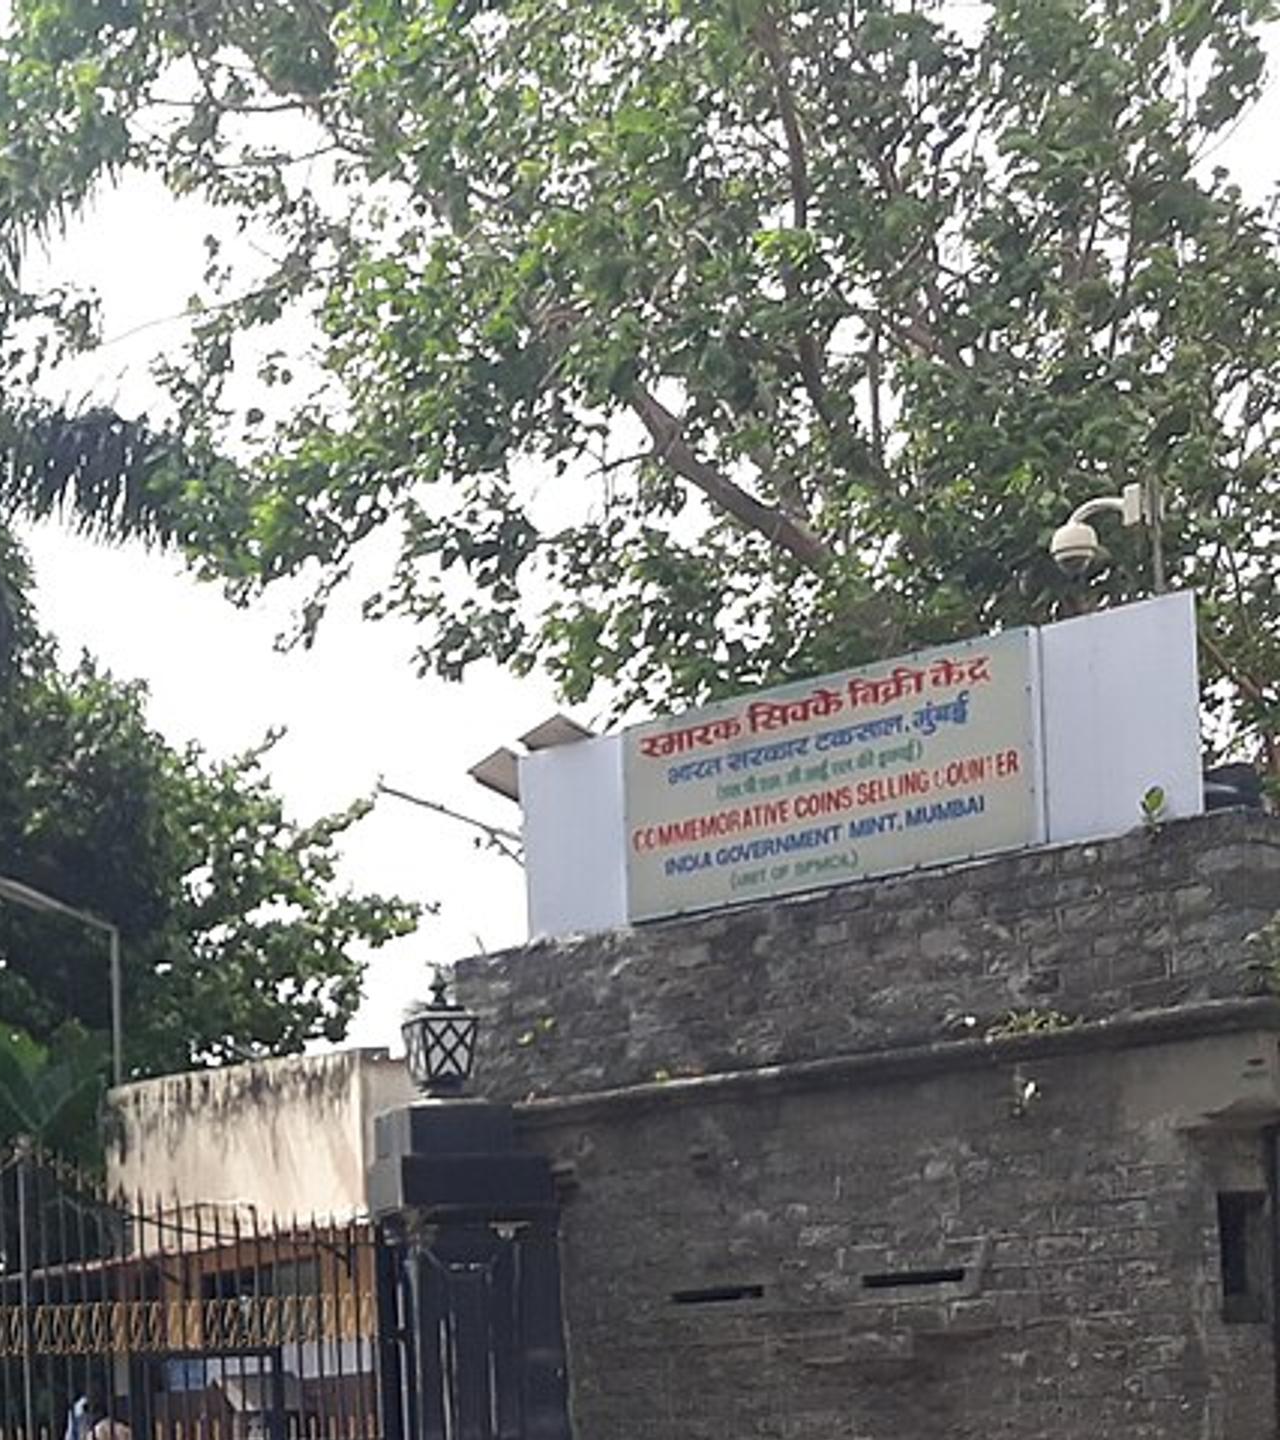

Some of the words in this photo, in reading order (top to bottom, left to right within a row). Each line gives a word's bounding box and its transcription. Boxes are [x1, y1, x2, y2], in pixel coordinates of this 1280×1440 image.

[641, 717, 741, 757] स्मारक
[668, 757, 721, 785] भारत
[727, 737, 809, 771] सरकार
[633, 801, 790, 853] COMMEMORATIVE
[794, 785, 853, 819] COINS
[856, 769, 930, 805] SELLING
[665, 850, 713, 876] INDIA
[716, 824, 843, 867] GOVERNMENT
[904, 795, 986, 827] MUMBAI
